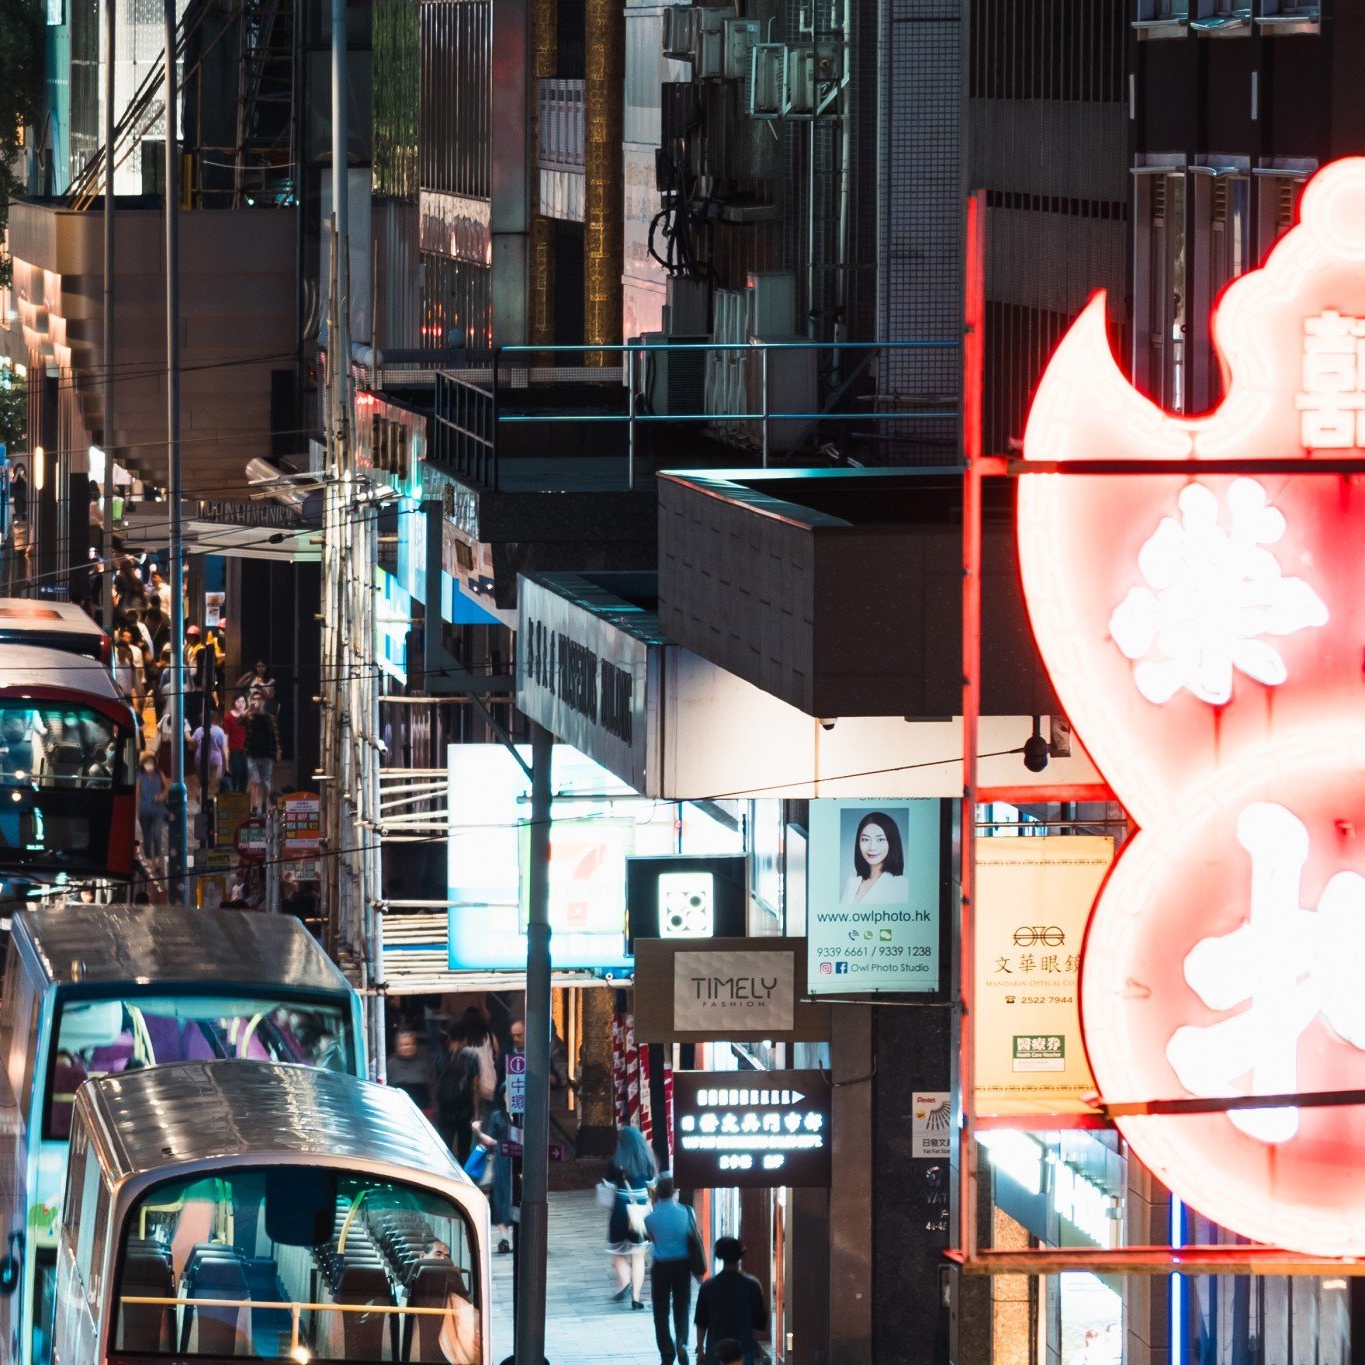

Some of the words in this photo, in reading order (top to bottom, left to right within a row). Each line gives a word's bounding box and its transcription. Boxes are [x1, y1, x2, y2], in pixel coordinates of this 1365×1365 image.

[817, 910, 931, 924] www.owlphoto.hk
[817, 947, 842, 957] 9339
[844, 947, 868, 957] 6661
[879, 947, 904, 957] 9339
[907, 947, 931, 957] 1238
[851, 964, 869, 972] Owl
[871, 964, 898, 972] Photo
[901, 964, 930, 972] Studio
[996, 953, 1082, 974] 文華眼鏡
[691, 977, 778, 999] TIMELY
[1021, 996, 1046, 1004] 2522
[1048, 996, 1073, 1004] 7944
[511, 1077, 525, 1109] 中環
